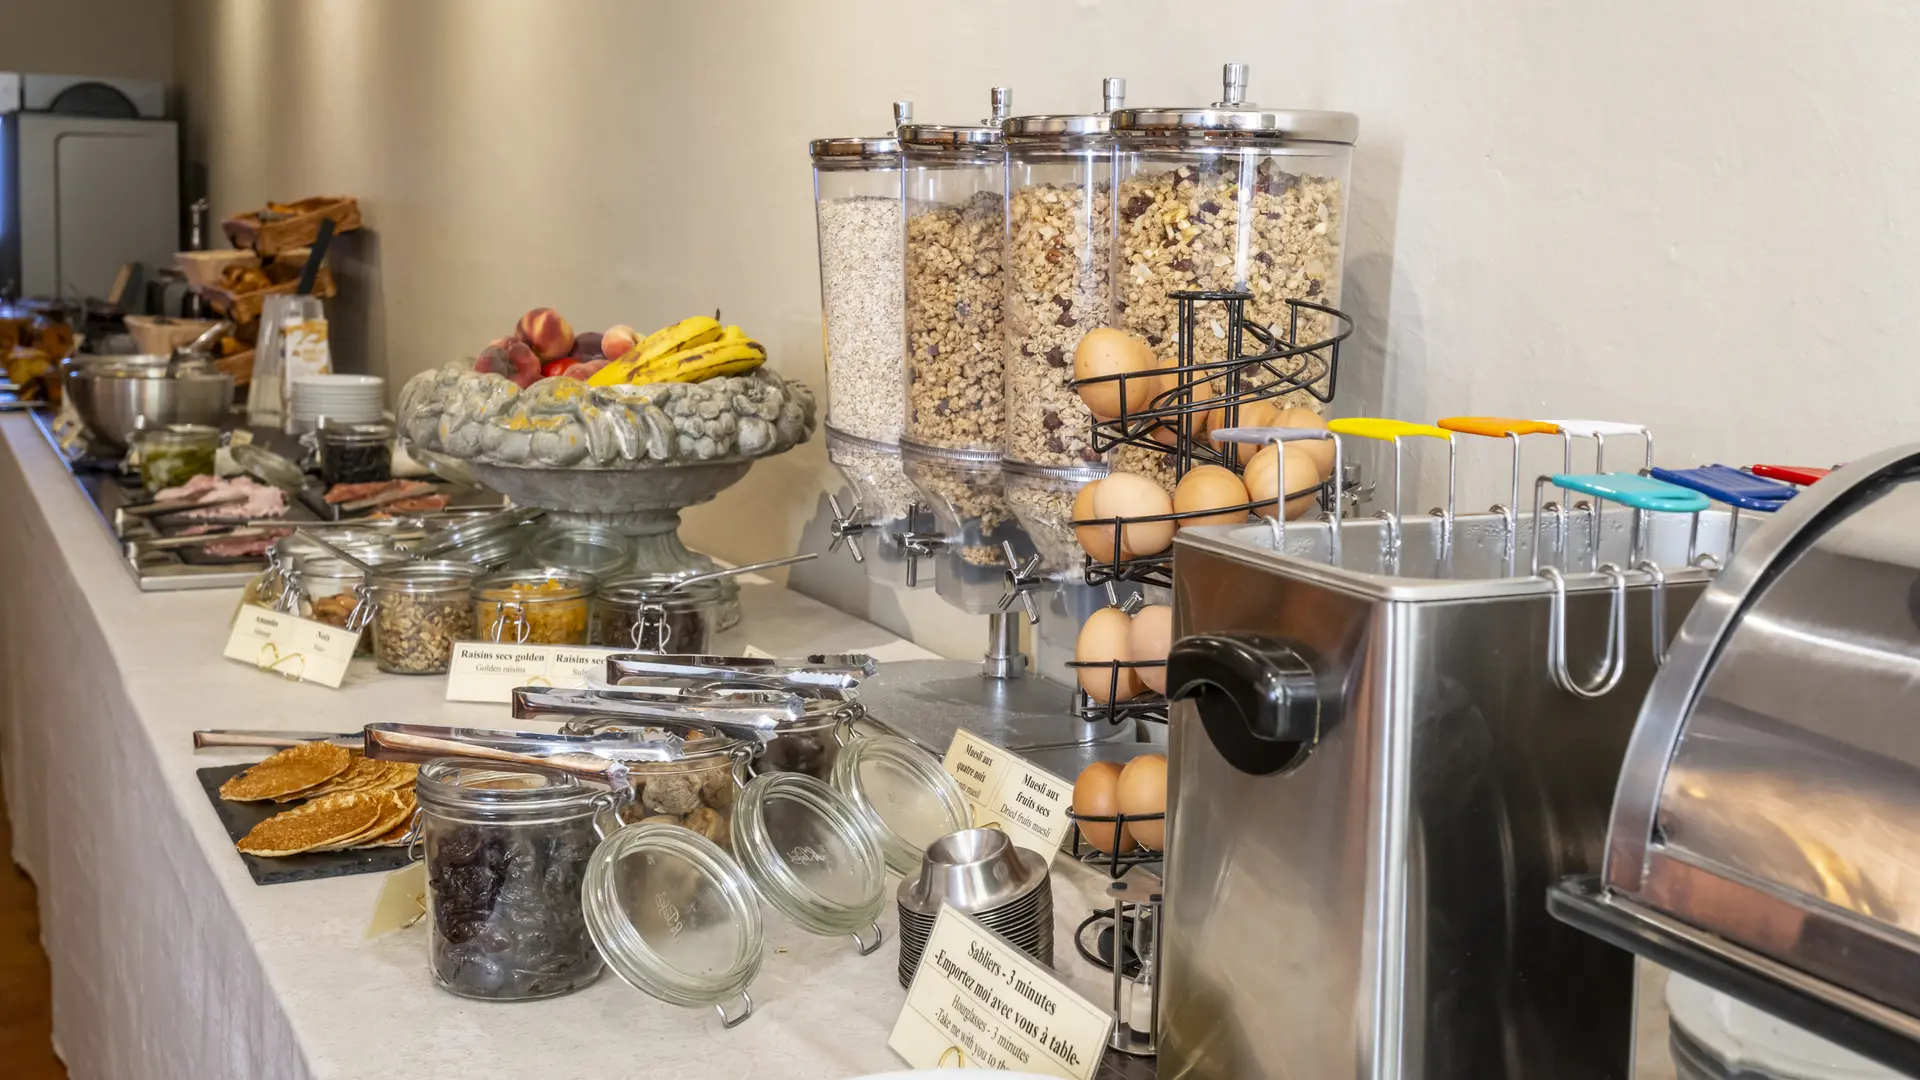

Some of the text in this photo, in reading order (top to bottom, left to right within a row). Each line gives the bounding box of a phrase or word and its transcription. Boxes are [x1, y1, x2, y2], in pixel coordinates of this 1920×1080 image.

[461, 649, 545, 662] Raisins secs golden
[475, 663, 526, 674] Golden raisins
[556, 653, 607, 665] Raisins sec
[965, 744, 994, 767] Muesli aux
[956, 761, 974, 778] quatre
[973, 770, 986, 783] noix
[1022, 774, 1061, 802] Muesli aux
[1015, 791, 1051, 818] fruits secs
[1000, 803, 1052, 839] Dried fruits muesli
[967, 940, 1002, 977] Sabliers
[1006, 969, 1016, 986] 3
[1014, 981, 1057, 1017] minutes
[934, 949, 1081, 1066] -Emportez moi avec vous à table-
[935, 1008, 1011, 1071] -Take me with you to th
[951, 994, 988, 1034] Hourglasses
[991, 1027, 999, 1040] 3
[997, 1036, 1030, 1065] minutes
